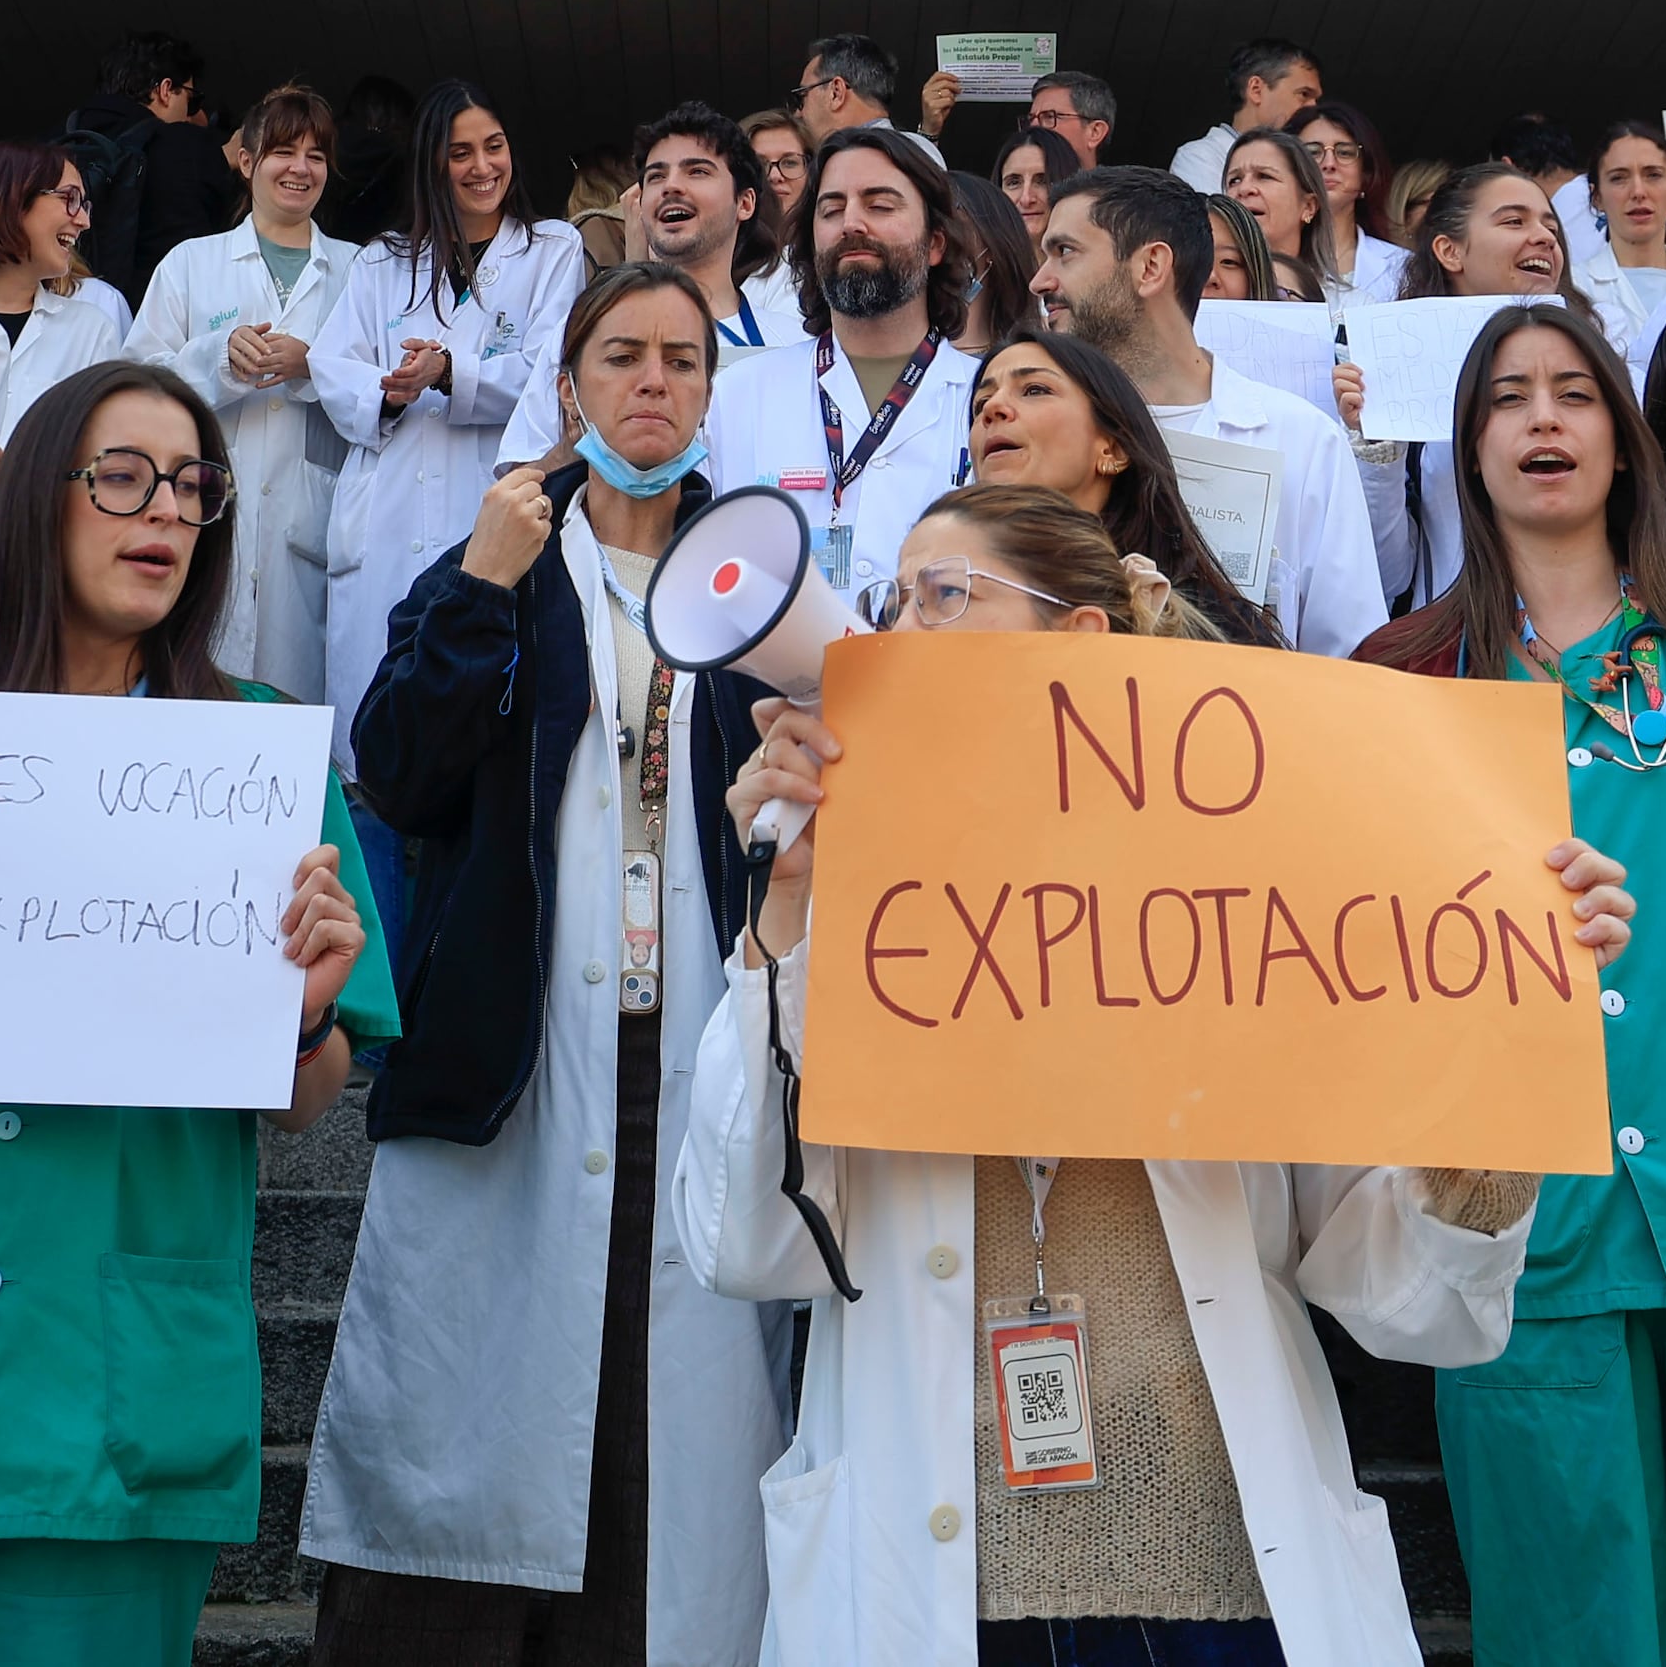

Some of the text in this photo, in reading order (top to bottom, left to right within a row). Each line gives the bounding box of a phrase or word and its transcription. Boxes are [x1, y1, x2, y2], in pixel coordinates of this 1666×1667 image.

[208, 306, 239, 330] salud
[1049, 677, 1264, 815] NO
[97, 754, 298, 825] VOCACIÓN
[864, 870, 1573, 1028] EXPLOTACIÓN
[1037, 1445, 1071, 1456] GOBIERNO
[1038, 1455, 1047, 1463] DE
